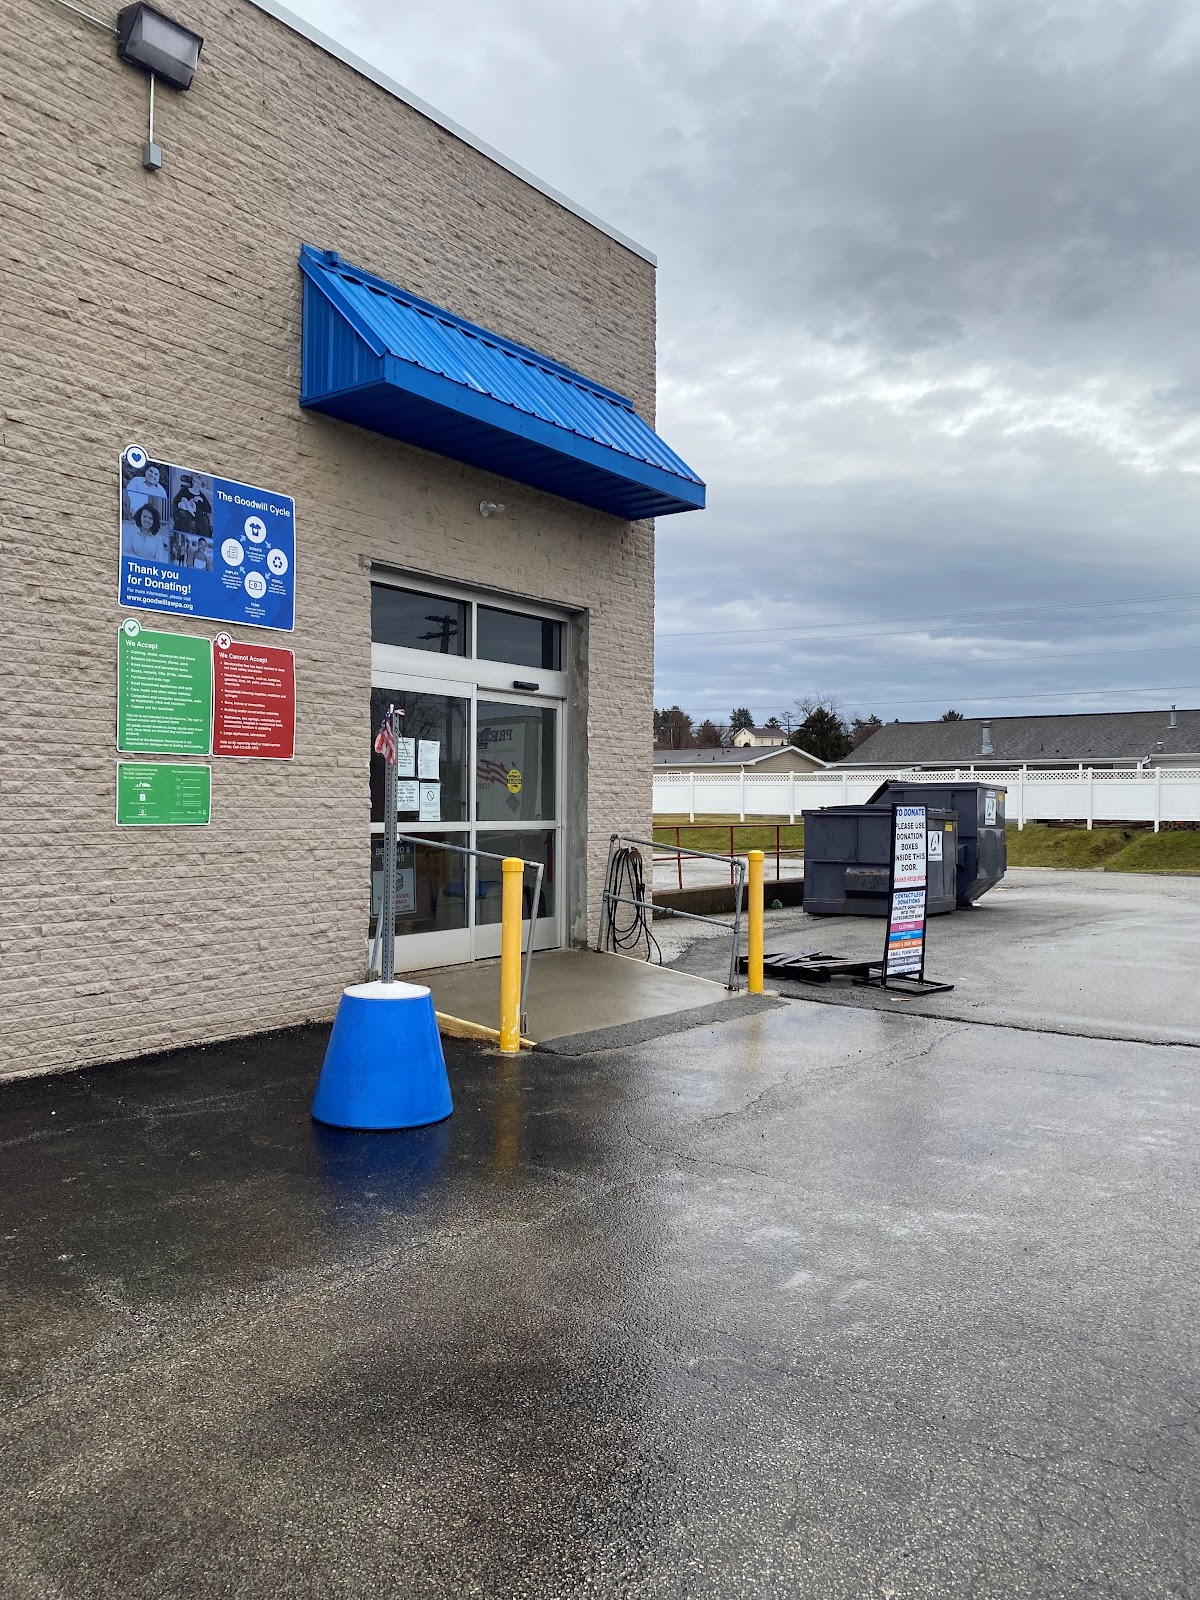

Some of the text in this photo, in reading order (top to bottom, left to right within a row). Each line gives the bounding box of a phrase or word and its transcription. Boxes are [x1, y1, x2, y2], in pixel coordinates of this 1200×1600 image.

[217, 490, 290, 517] The Goodwill Cycle
[128, 562, 178, 579] Thank you
[127, 574, 191, 595] for Donating!
[146, 590, 169, 598] information,
[137, 641, 158, 650] Accept
[376, 847, 404, 855] BENG
